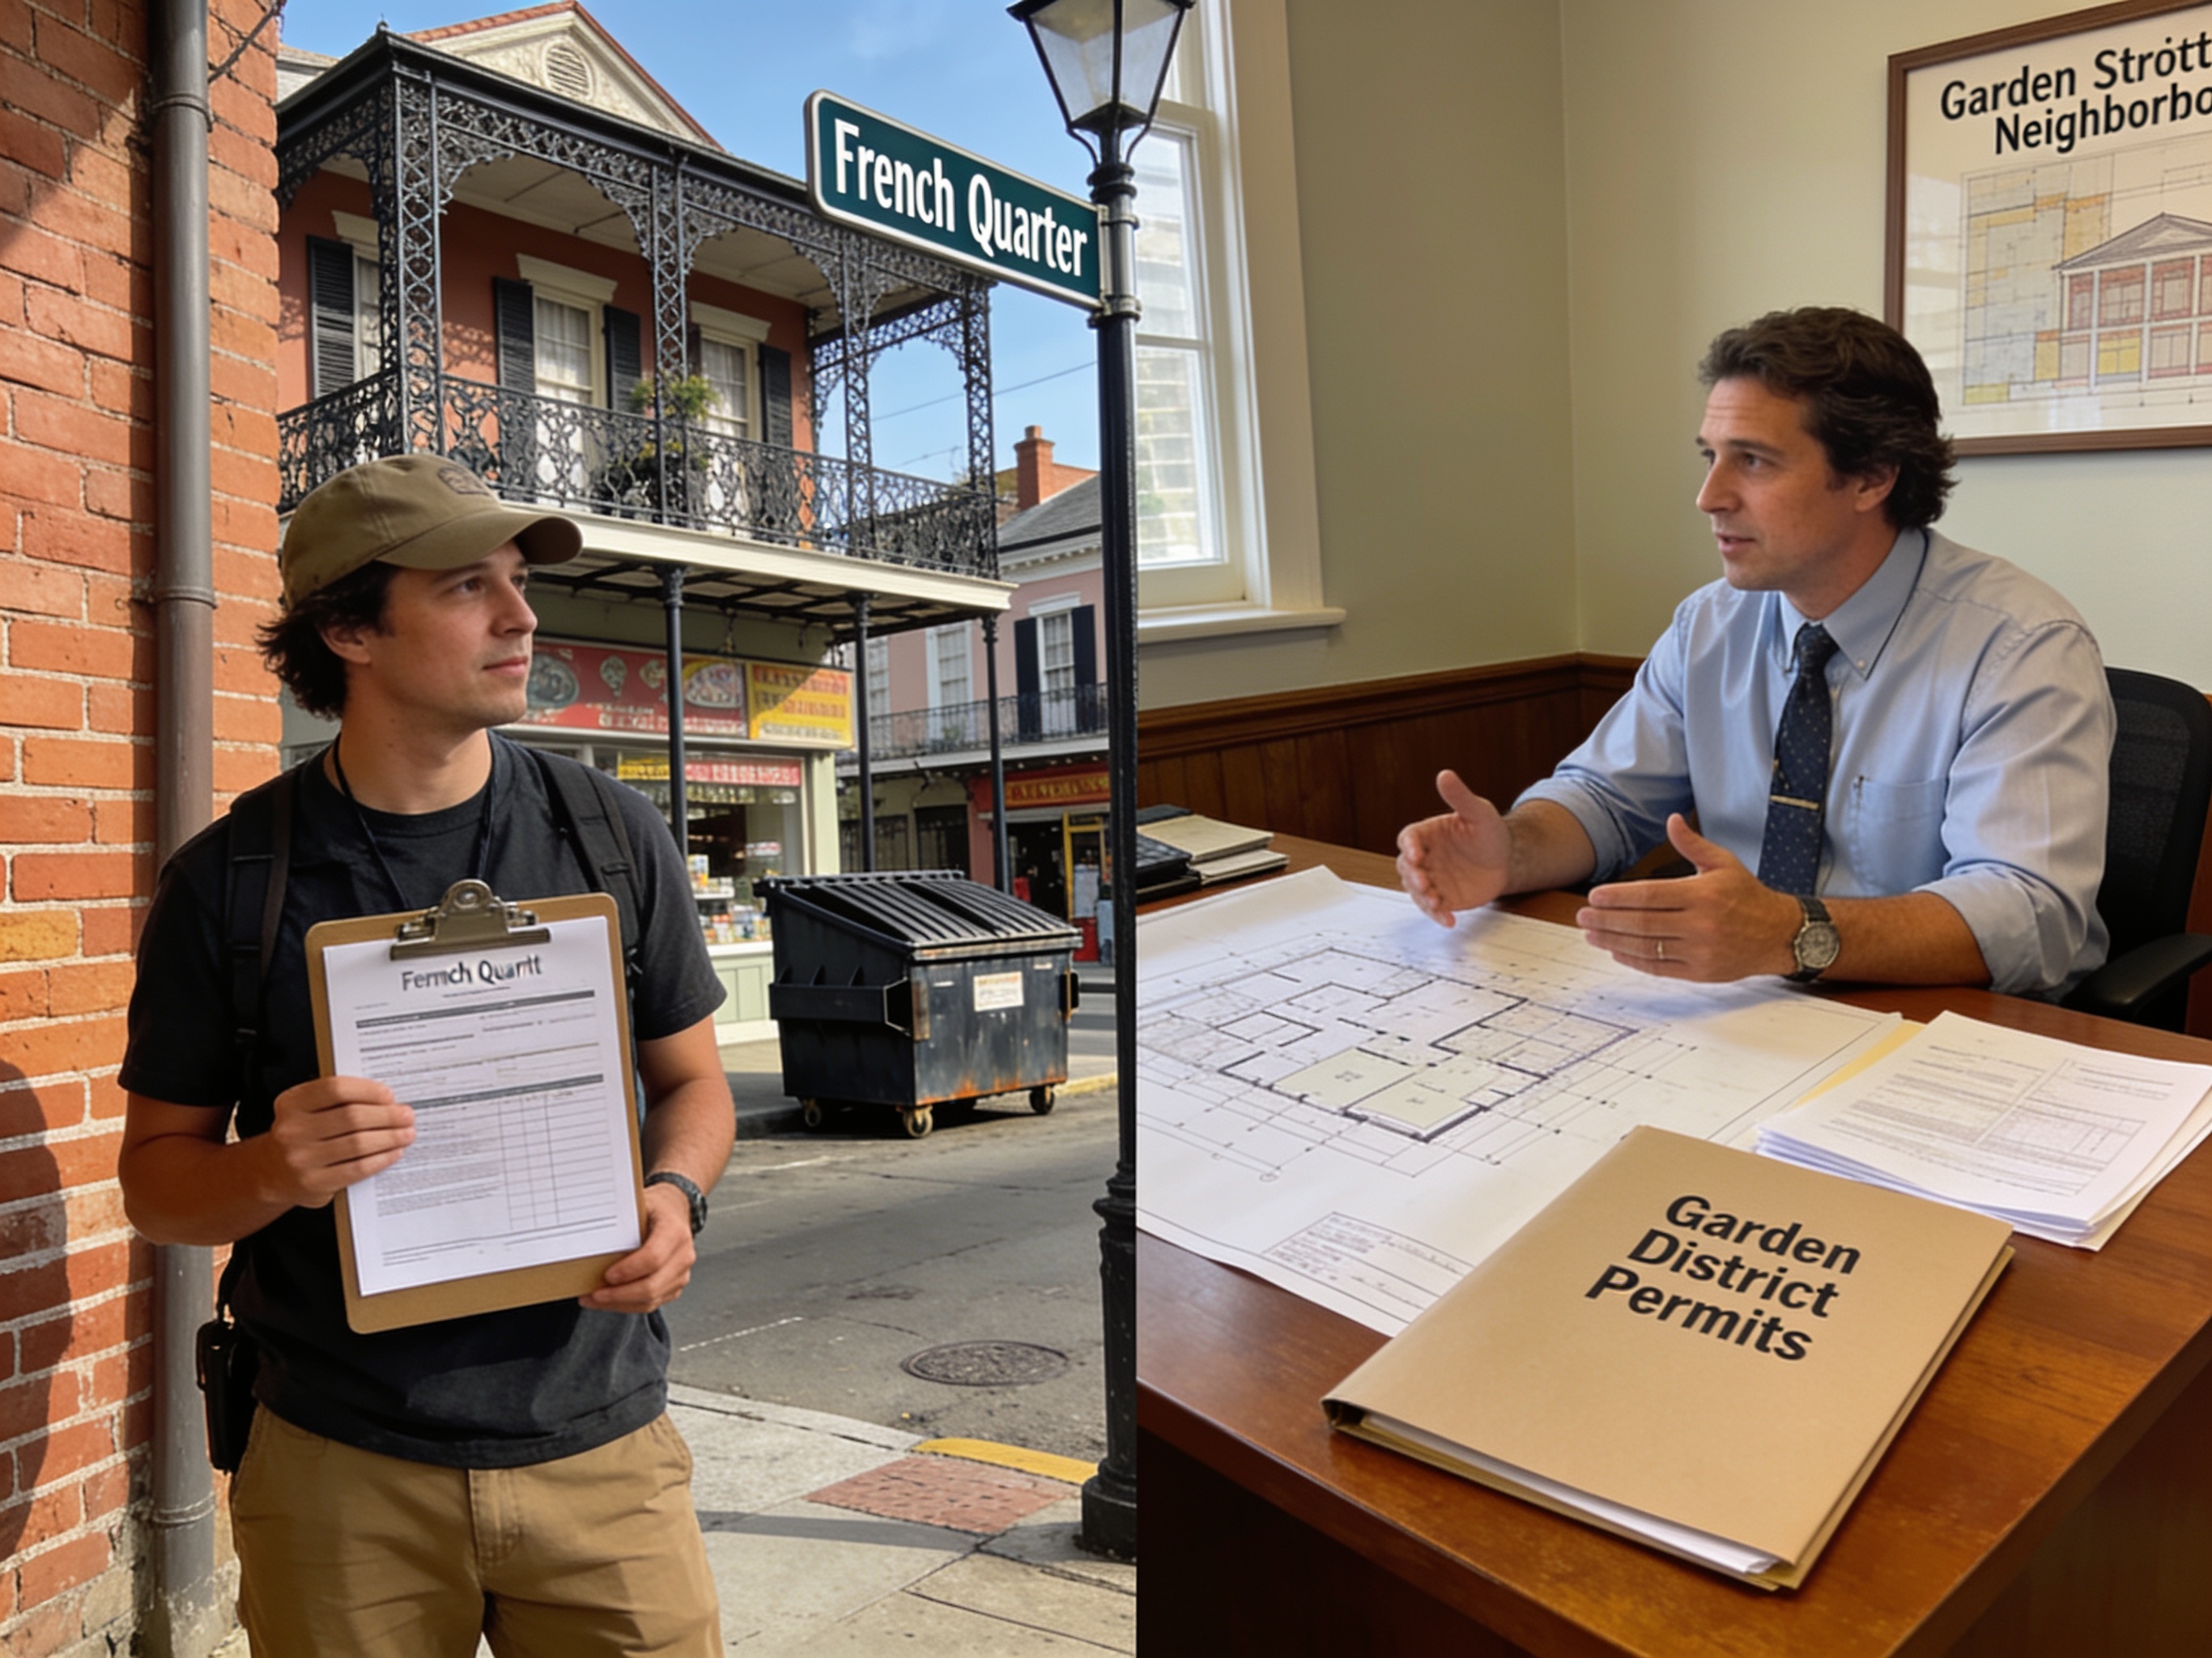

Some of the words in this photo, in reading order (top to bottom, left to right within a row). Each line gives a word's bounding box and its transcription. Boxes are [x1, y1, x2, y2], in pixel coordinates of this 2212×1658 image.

[1940, 65, 2077, 121] Garden
[834, 118, 955, 233] French
[968, 172, 1088, 278] Quarter
[1627, 1227, 1840, 1319] District
[1665, 1194, 1861, 1275] Garden
[1584, 1264, 1814, 1361] Permits
